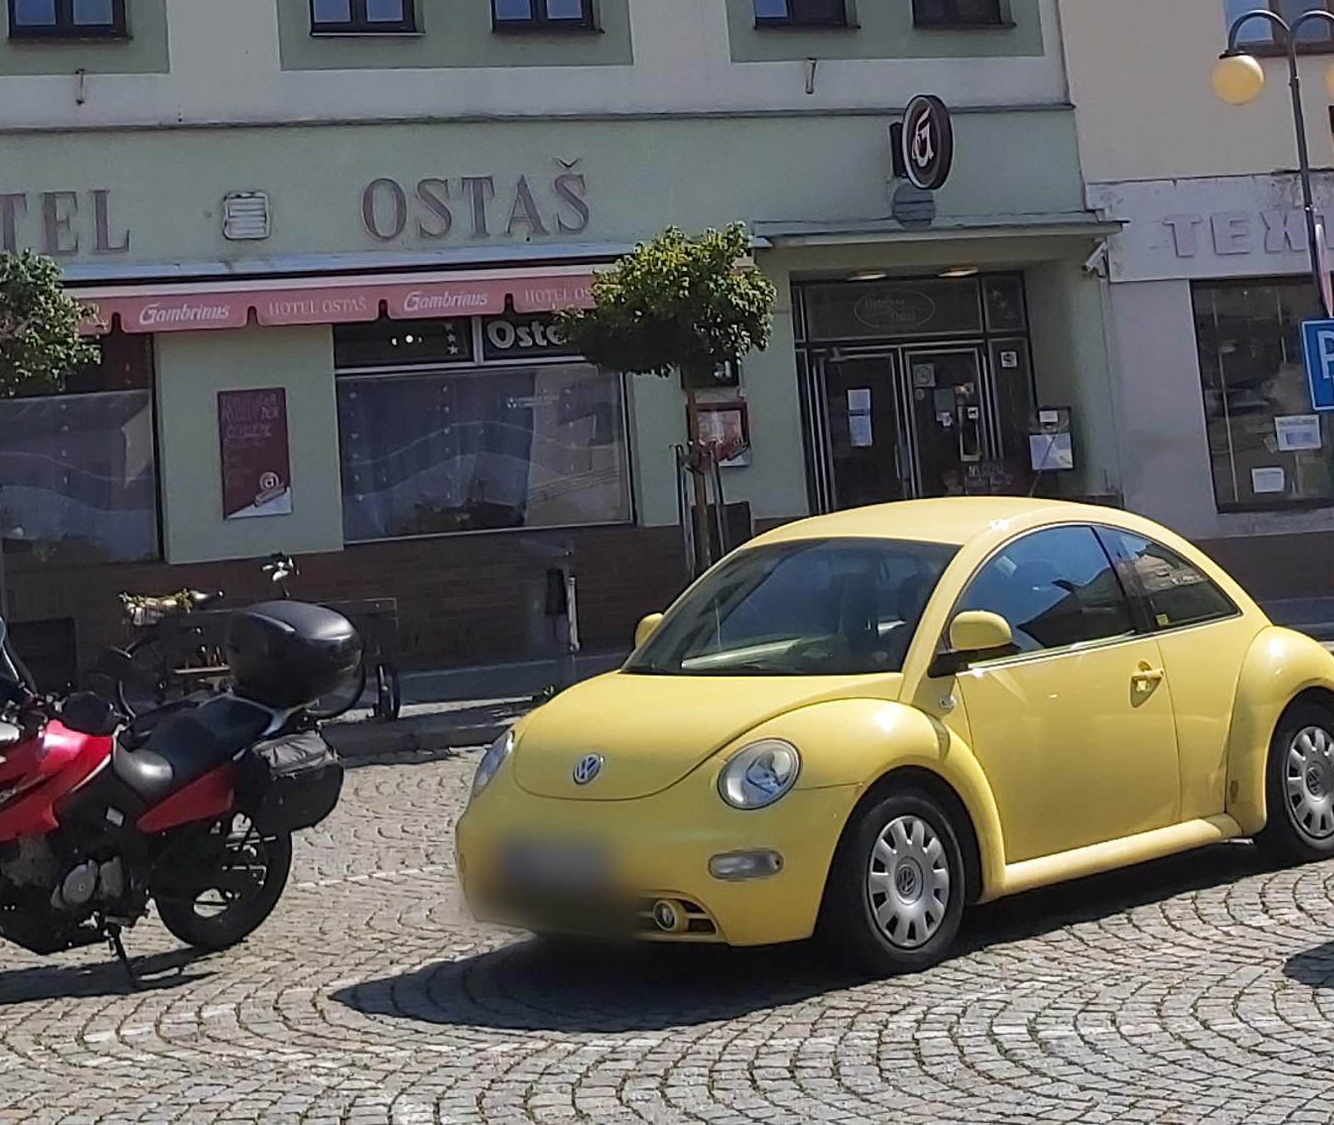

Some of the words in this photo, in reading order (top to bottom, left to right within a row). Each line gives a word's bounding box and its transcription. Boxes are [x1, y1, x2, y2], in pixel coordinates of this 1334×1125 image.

[362, 156, 590, 242] OSTAŠ
[269, 300, 317, 316] HOTEL
[322, 296, 367, 313] OSTAŠ
[403, 290, 488, 312] Gambrinus
[139, 302, 230, 325] Gambrinus
